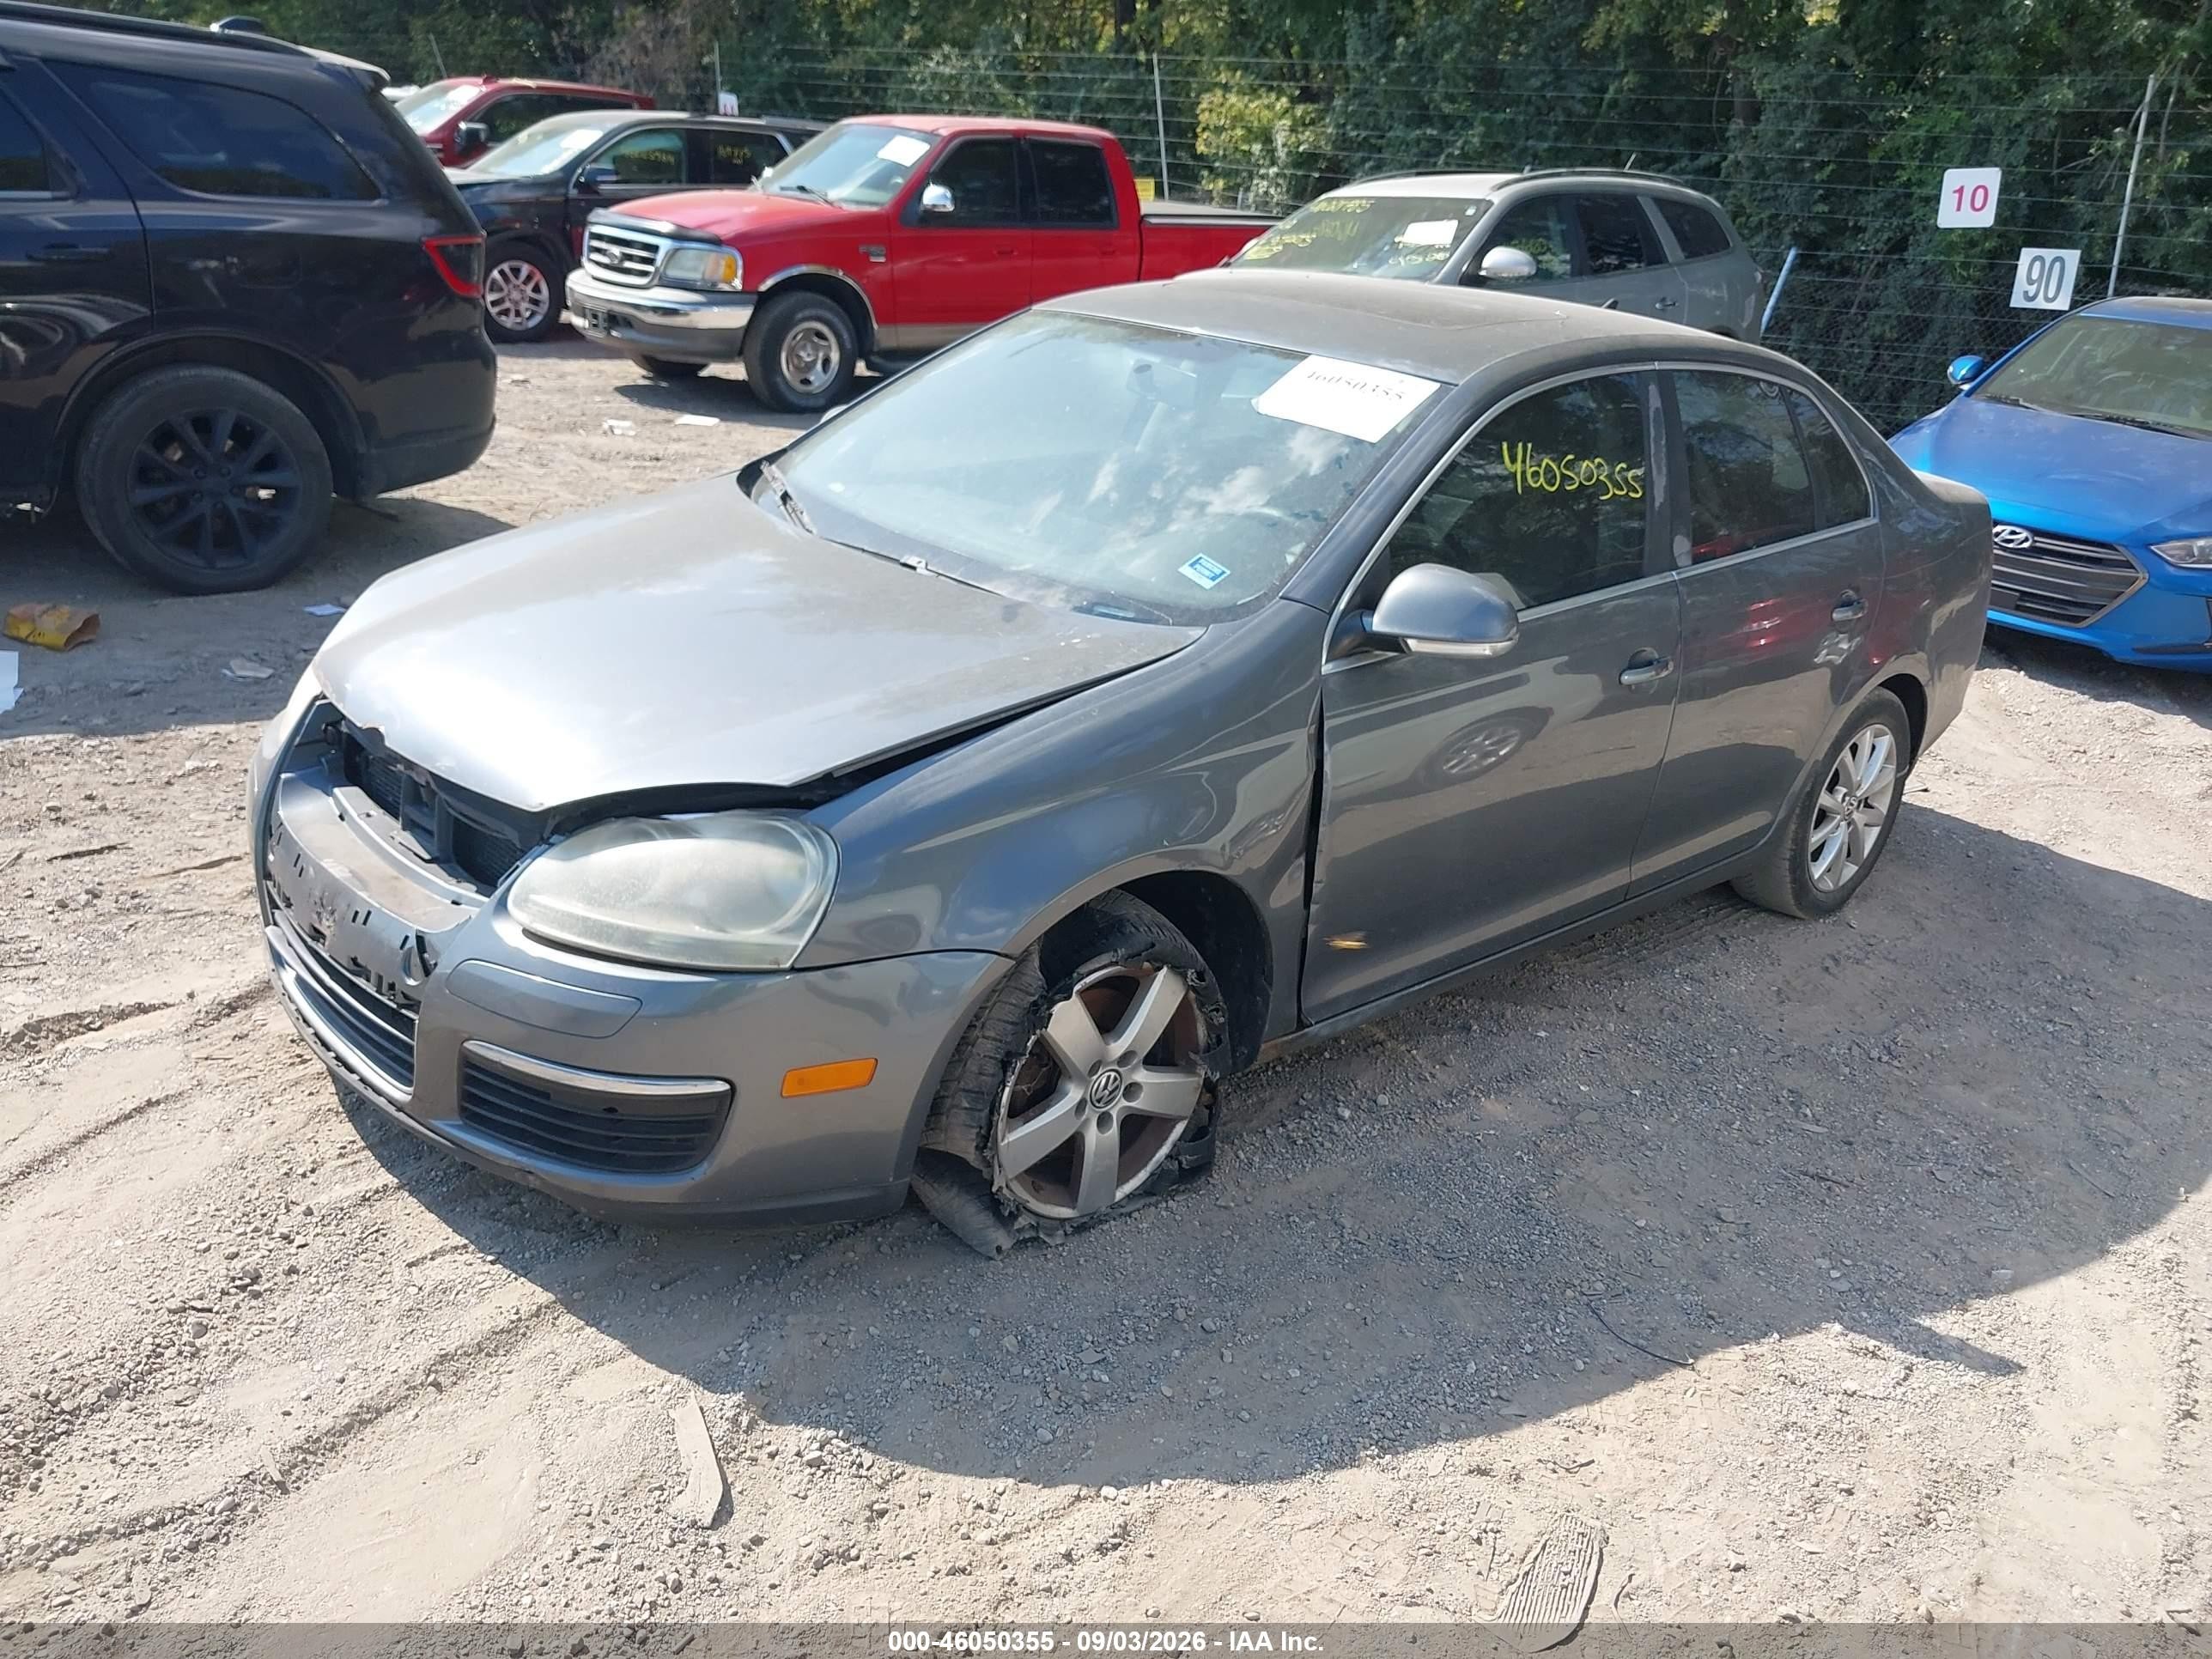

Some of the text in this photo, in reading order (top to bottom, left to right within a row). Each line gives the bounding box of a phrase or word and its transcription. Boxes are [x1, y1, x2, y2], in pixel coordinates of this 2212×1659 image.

[1952, 185, 1990, 213] 10
[2022, 255, 2066, 304] 90
[1502, 441, 1646, 501] 46050355
